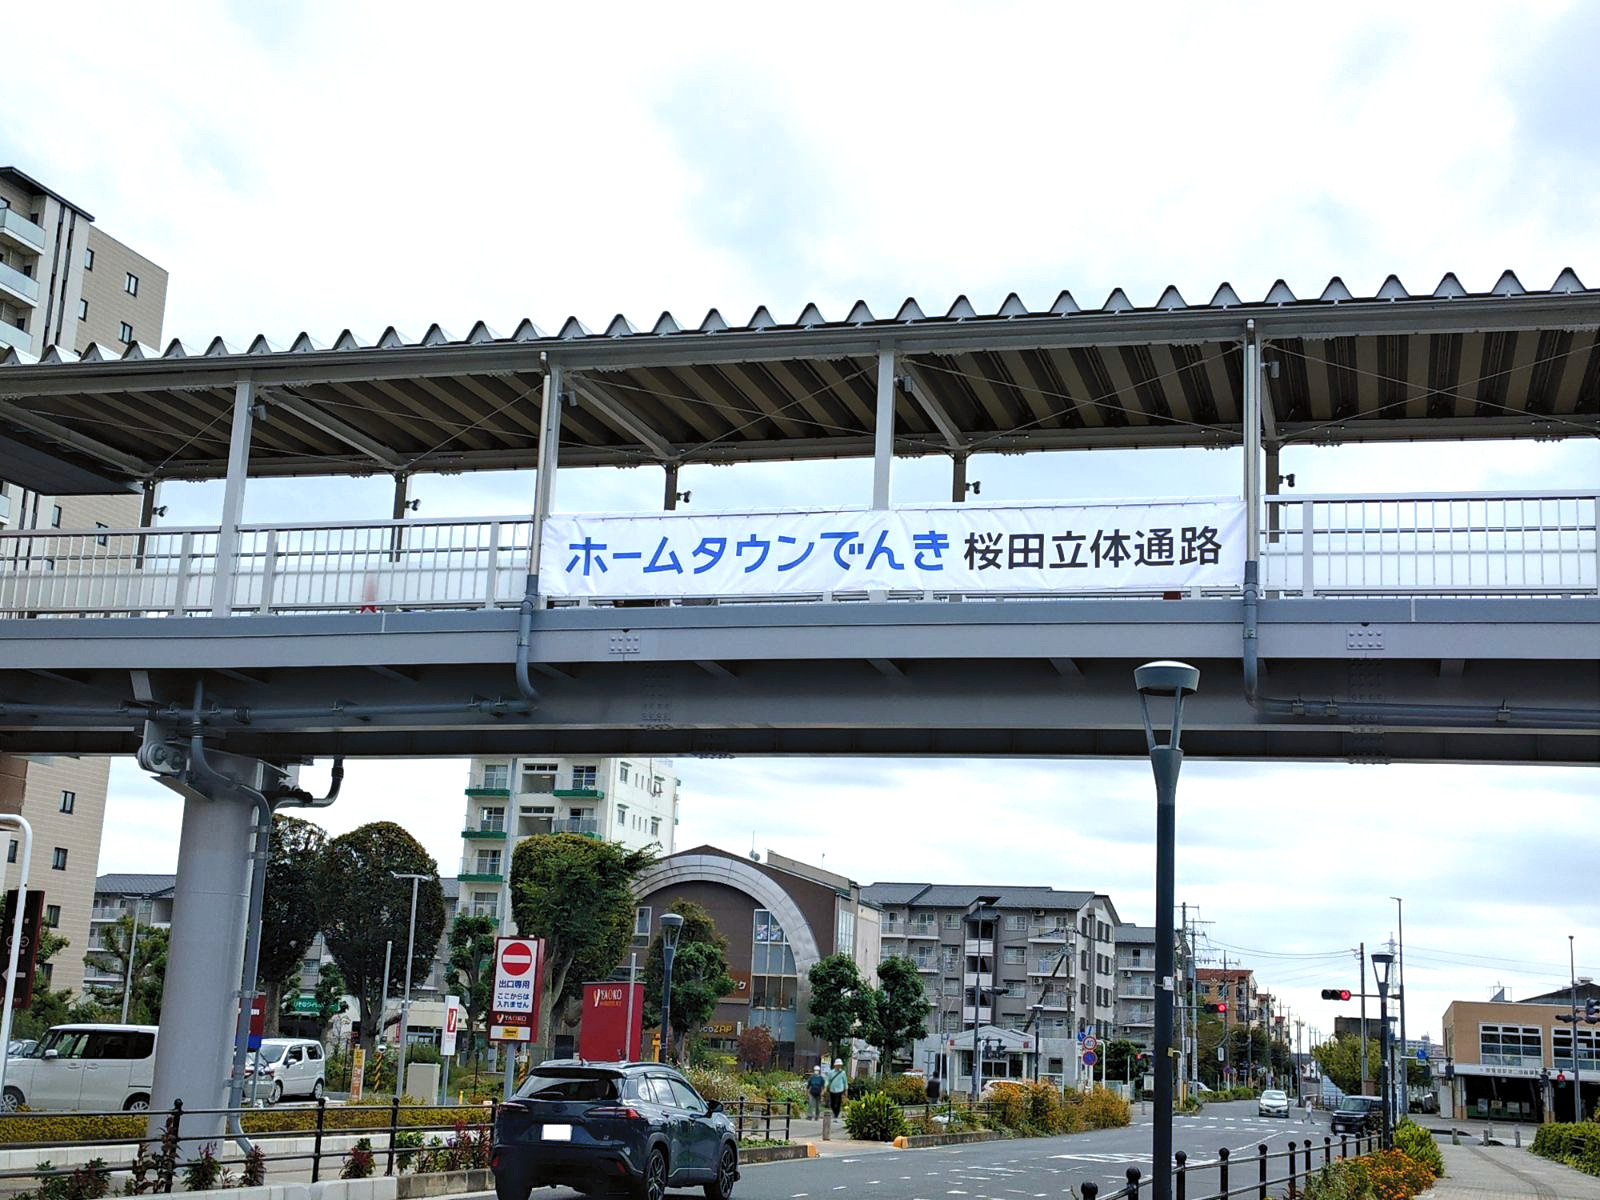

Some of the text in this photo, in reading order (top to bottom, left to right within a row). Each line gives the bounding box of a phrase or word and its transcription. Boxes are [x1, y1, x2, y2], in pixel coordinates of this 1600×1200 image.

[566, 526, 1222, 577] ホームタウンでんき 桜田立体通路
[498, 979, 530, 989] 出口専用
[497, 992, 529, 1000] ここからは
[601, 988, 622, 1000] YAOKO
[496, 1000, 529, 1009] 入れません
[504, 1014, 527, 1022] YAOKO
